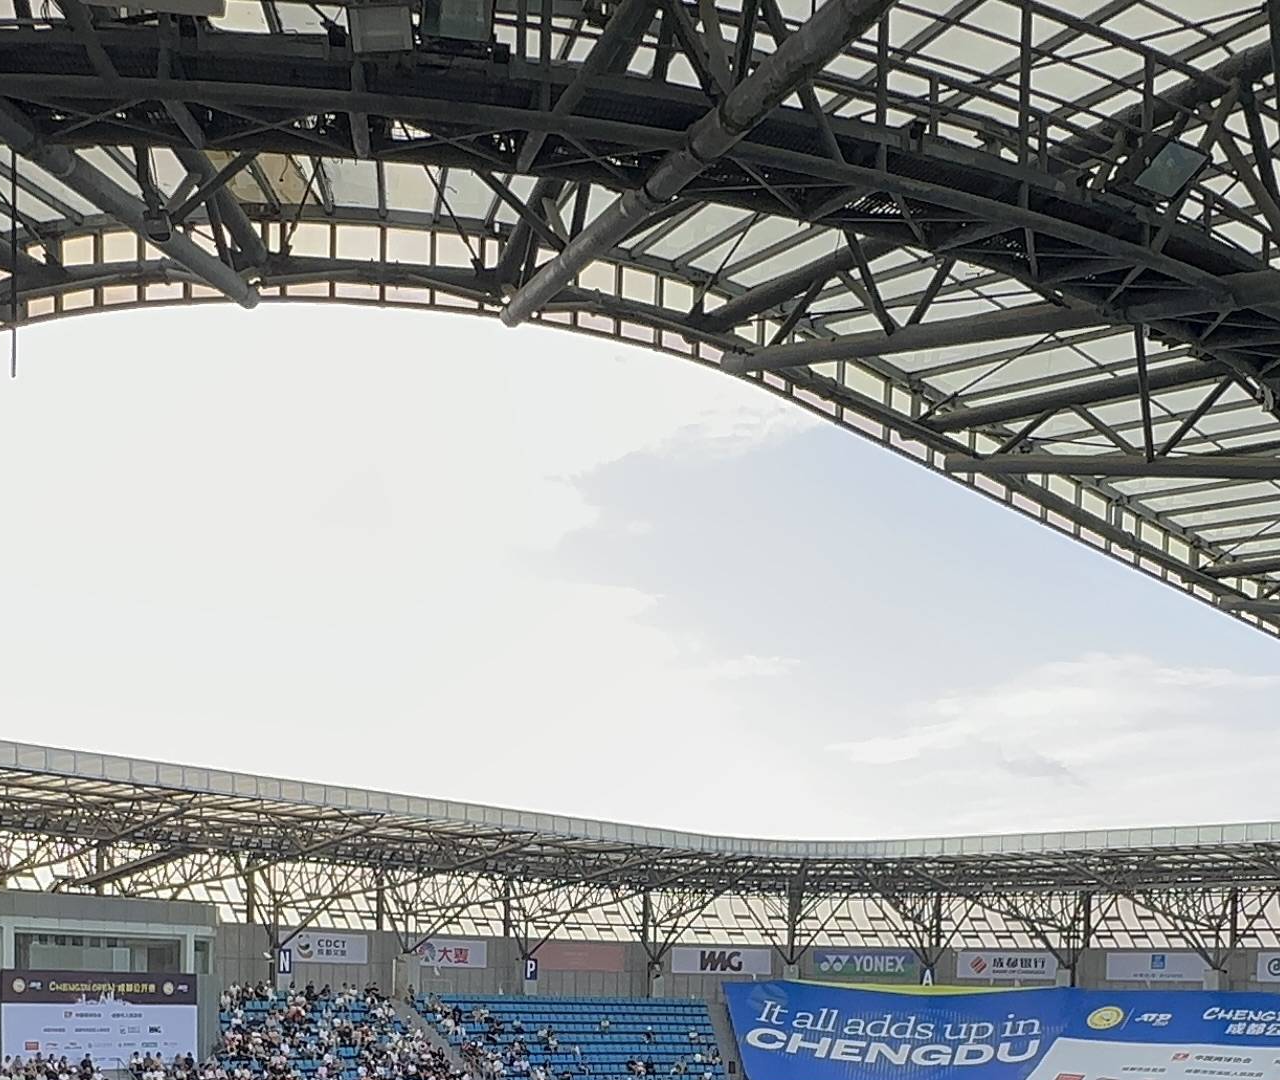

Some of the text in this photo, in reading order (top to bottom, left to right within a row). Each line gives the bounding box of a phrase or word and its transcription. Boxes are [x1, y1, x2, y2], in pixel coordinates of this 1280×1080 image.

[317, 938, 348, 949] CDCT
[279, 952, 291, 973] N
[526, 960, 536, 978] P
[853, 955, 906, 972] YONEX
[922, 968, 933, 986] A
[756, 1001, 1041, 1043] It all adds up in
[1135, 1013, 1172, 1023] ATP
[746, 1028, 1040, 1066] CHENGDU
